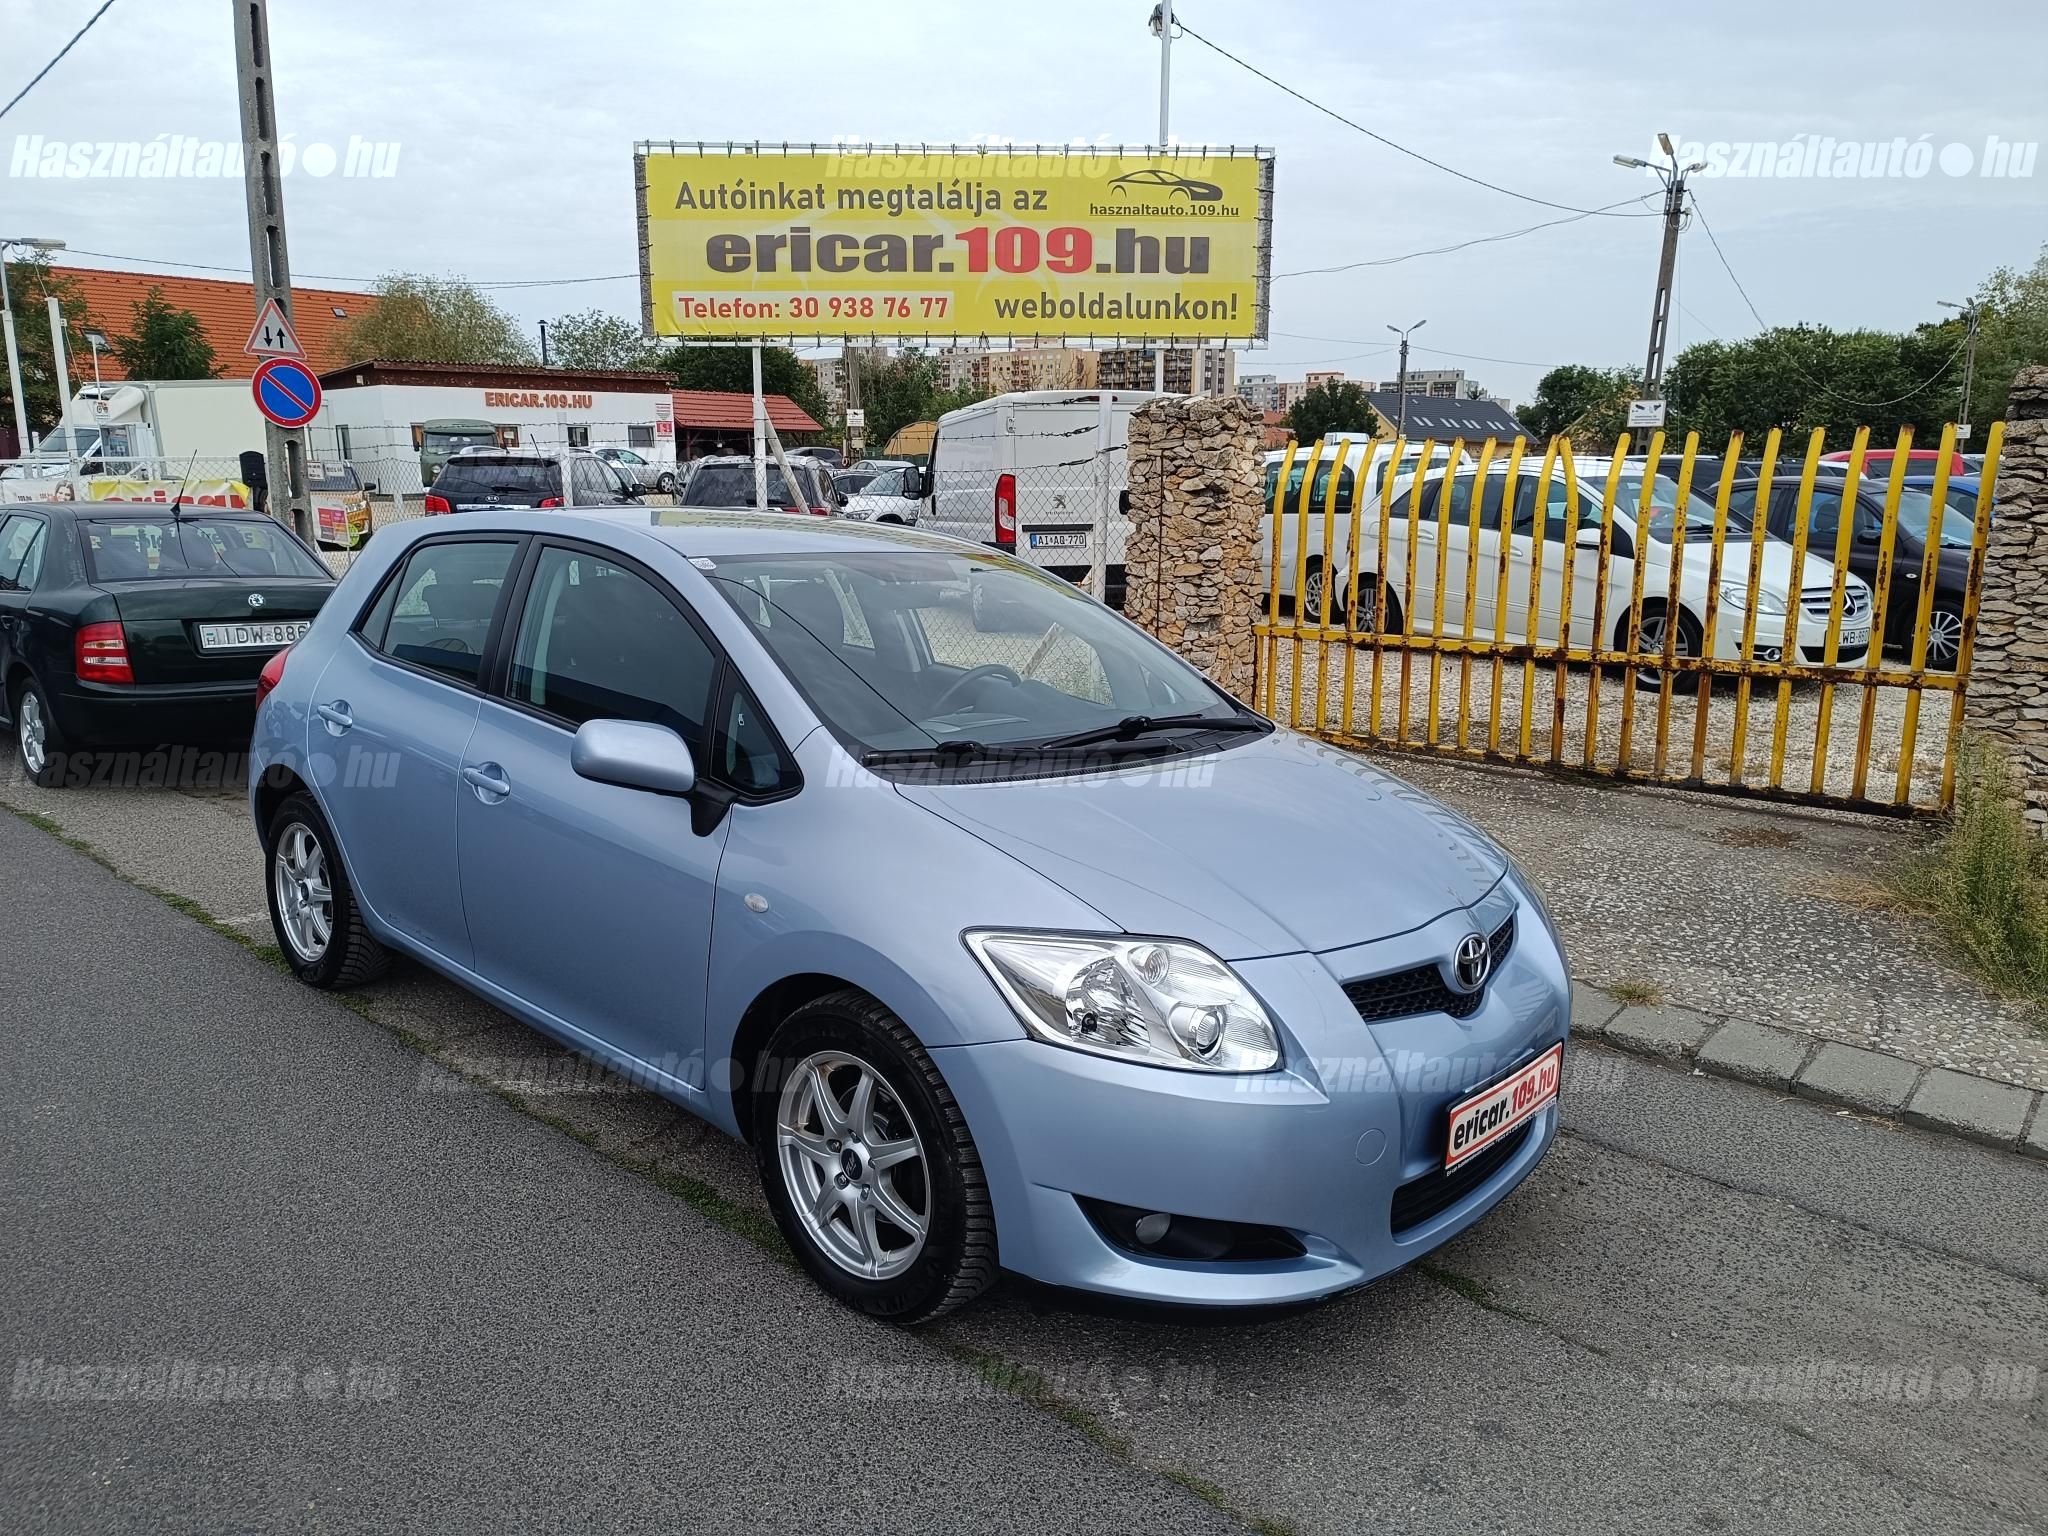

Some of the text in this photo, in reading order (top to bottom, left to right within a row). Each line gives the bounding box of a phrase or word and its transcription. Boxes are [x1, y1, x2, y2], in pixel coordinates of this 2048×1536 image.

[675, 178, 1048, 217] Autóinkat megtalálja az
[1089, 203, 1240, 217] hasznaltauto.109.hu
[706, 226, 1210, 274] ericar.109.hu
[679, 297, 948, 318] Telefon: 30 938 76 77
[995, 291, 1238, 321] weboldalunkon!
[485, 391, 593, 409] ERICAR.109.HU
[1454, 1064, 1555, 1150] ericar.109.hu
